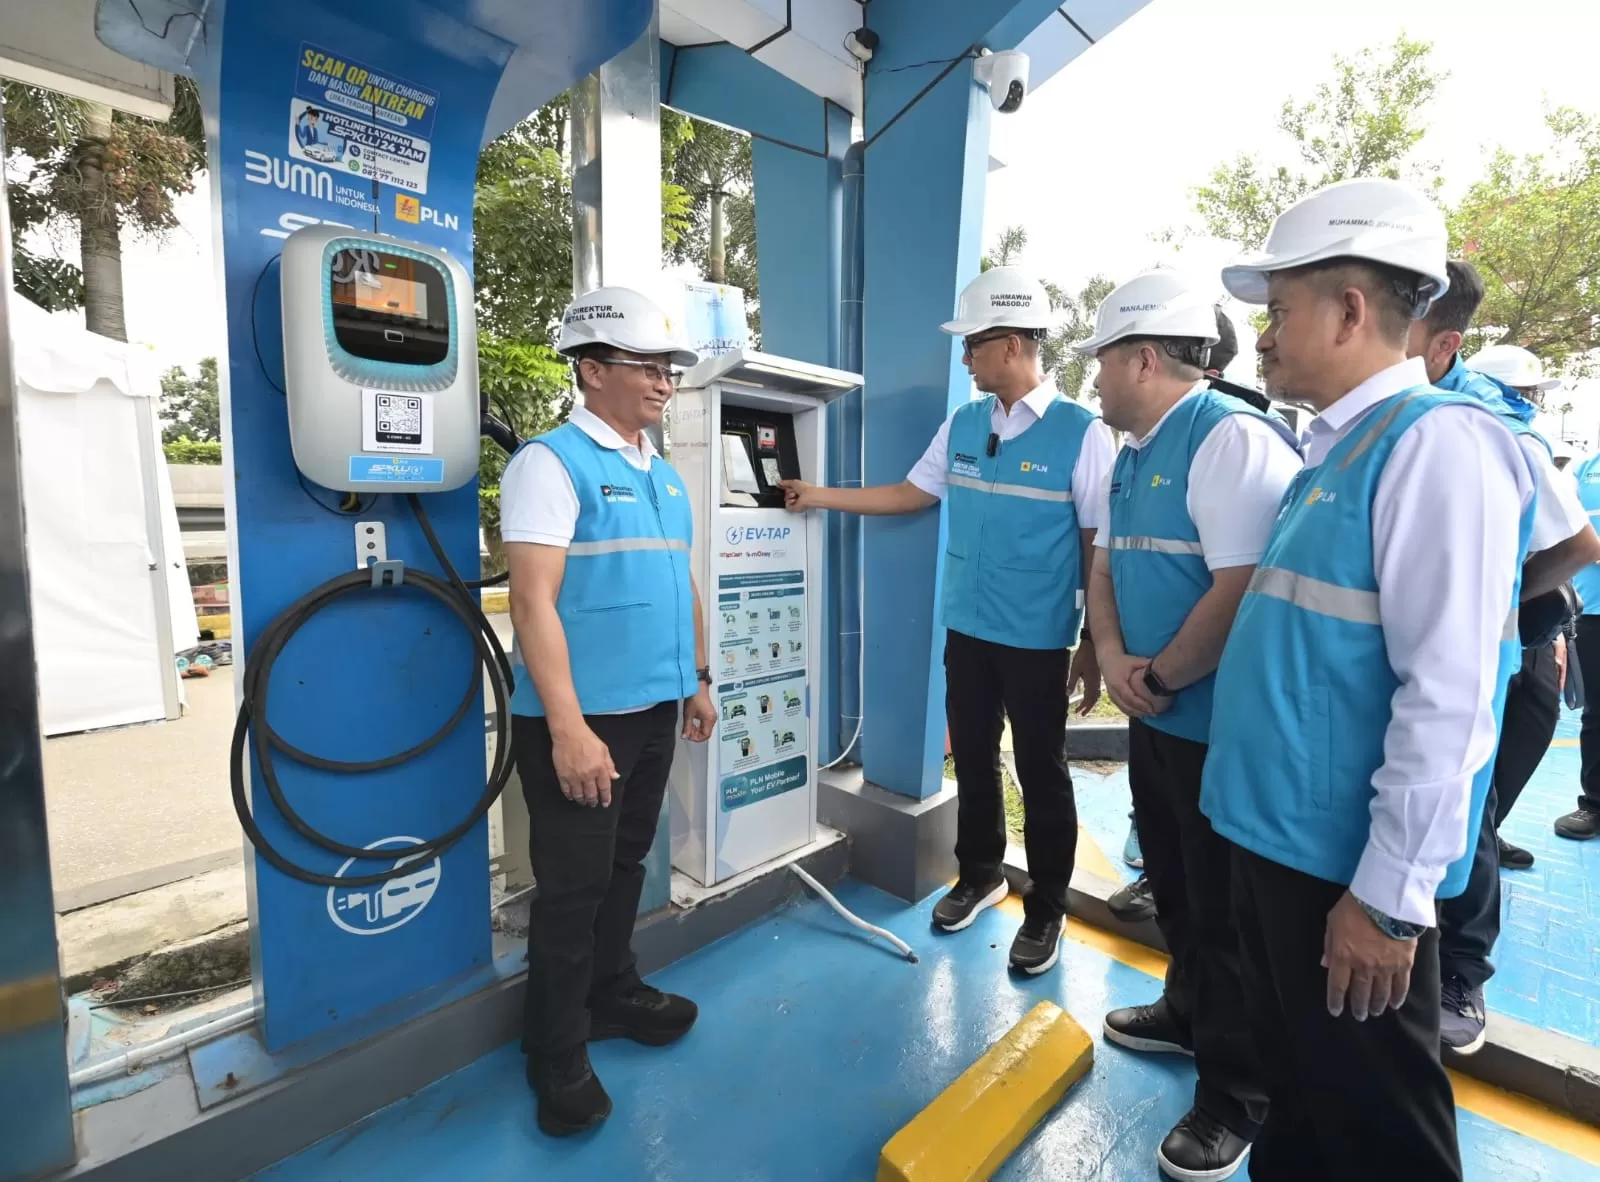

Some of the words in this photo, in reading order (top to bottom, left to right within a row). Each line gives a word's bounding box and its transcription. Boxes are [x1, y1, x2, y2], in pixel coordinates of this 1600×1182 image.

[302, 49, 346, 78] SCAN
[346, 66, 369, 86] QR
[367, 72, 397, 92] UNTUK
[395, 83, 436, 106] CHARGING
[308, 71, 328, 87] DAN
[327, 78, 361, 99] MASUK
[360, 84, 427, 120] ANTREAN
[326, 115, 366, 132] HOTLINE
[368, 128, 410, 147] LAYANAN
[381, 140, 396, 152] 24
[398, 146, 424, 161] JAM
[363, 154, 376, 162] 123
[391, 175, 404, 185] 1112
[406, 181, 418, 189] 123
[336, 186, 365, 200] UNTUK
[335, 195, 381, 215] INDONESIA
[420, 206, 459, 231] PLN
[1328, 218, 1374, 227] MUHAMMAD
[573, 305, 612, 315] DIREKTUR
[596, 311, 624, 319] NIAGA
[1032, 463, 1048, 473] PLN
[746, 527, 791, 540] EV-TAP
[750, 775, 764, 786] PLN
[765, 770, 785, 781] Mobile
